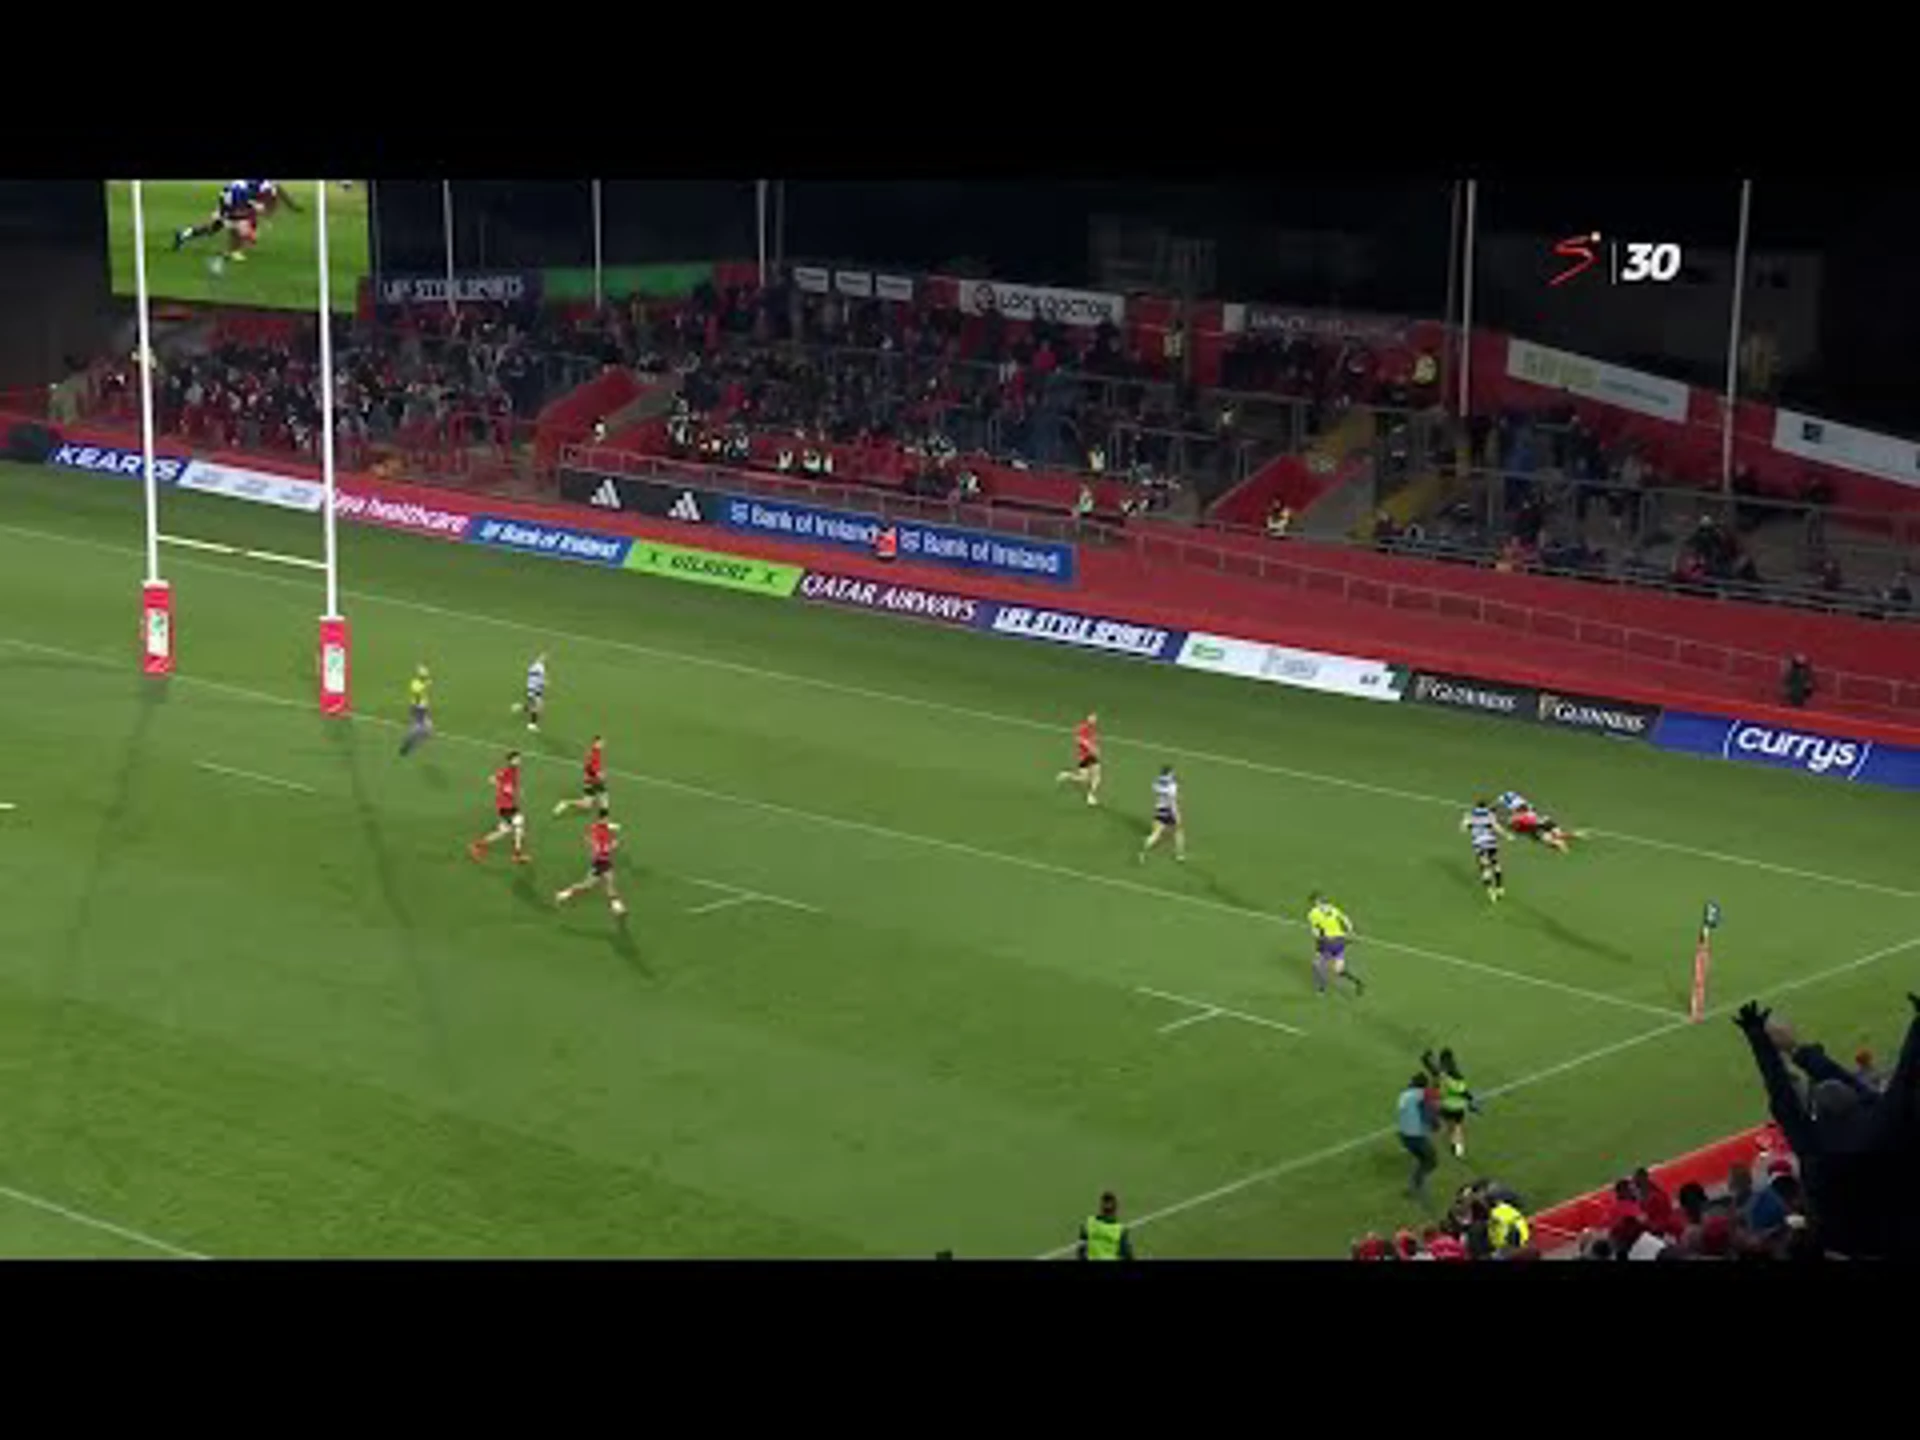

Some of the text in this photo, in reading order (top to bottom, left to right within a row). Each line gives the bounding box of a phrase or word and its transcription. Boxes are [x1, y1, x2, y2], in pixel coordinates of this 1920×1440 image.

[1000, 291, 1112, 320] LOCK DOCTOR
[55, 443, 181, 481] KEARS
[367, 498, 469, 533] healthcare
[752, 503, 880, 546] Bank of Ireland
[500, 523, 621, 561] Bank of Ireland
[923, 532, 1058, 574] Bank of Ireland
[671, 555, 753, 582] GILBERT
[802, 576, 977, 621] QATAR AIRWAYS
[993, 607, 1036, 633] LIFE
[1035, 611, 1092, 642] STYLE
[1092, 620, 1169, 655] SPORTS
[1431, 683, 1517, 712] GUINNESS
[1554, 702, 1645, 732] GUINNESS
[1737, 727, 1857, 773] currys
